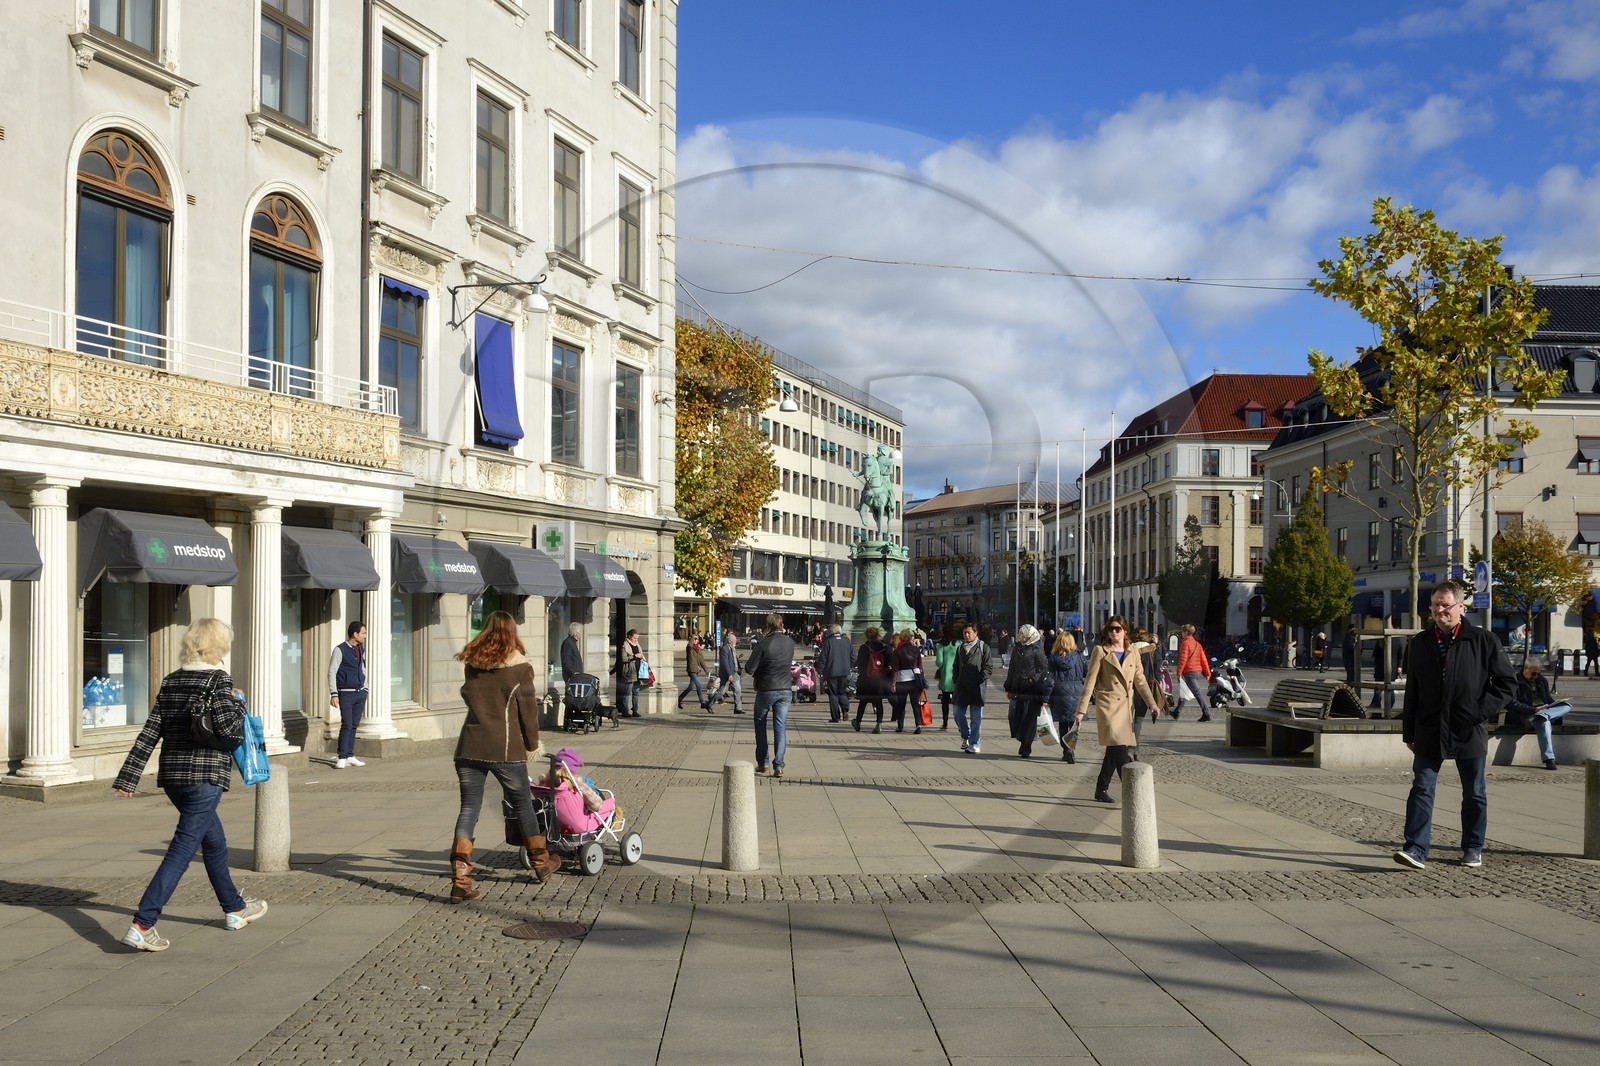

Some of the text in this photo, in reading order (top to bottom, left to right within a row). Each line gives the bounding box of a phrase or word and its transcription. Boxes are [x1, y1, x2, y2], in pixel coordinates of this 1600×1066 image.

[173, 544, 226, 561] medstop
[444, 562, 477, 575] medstop
[603, 572, 626, 583] medstop
